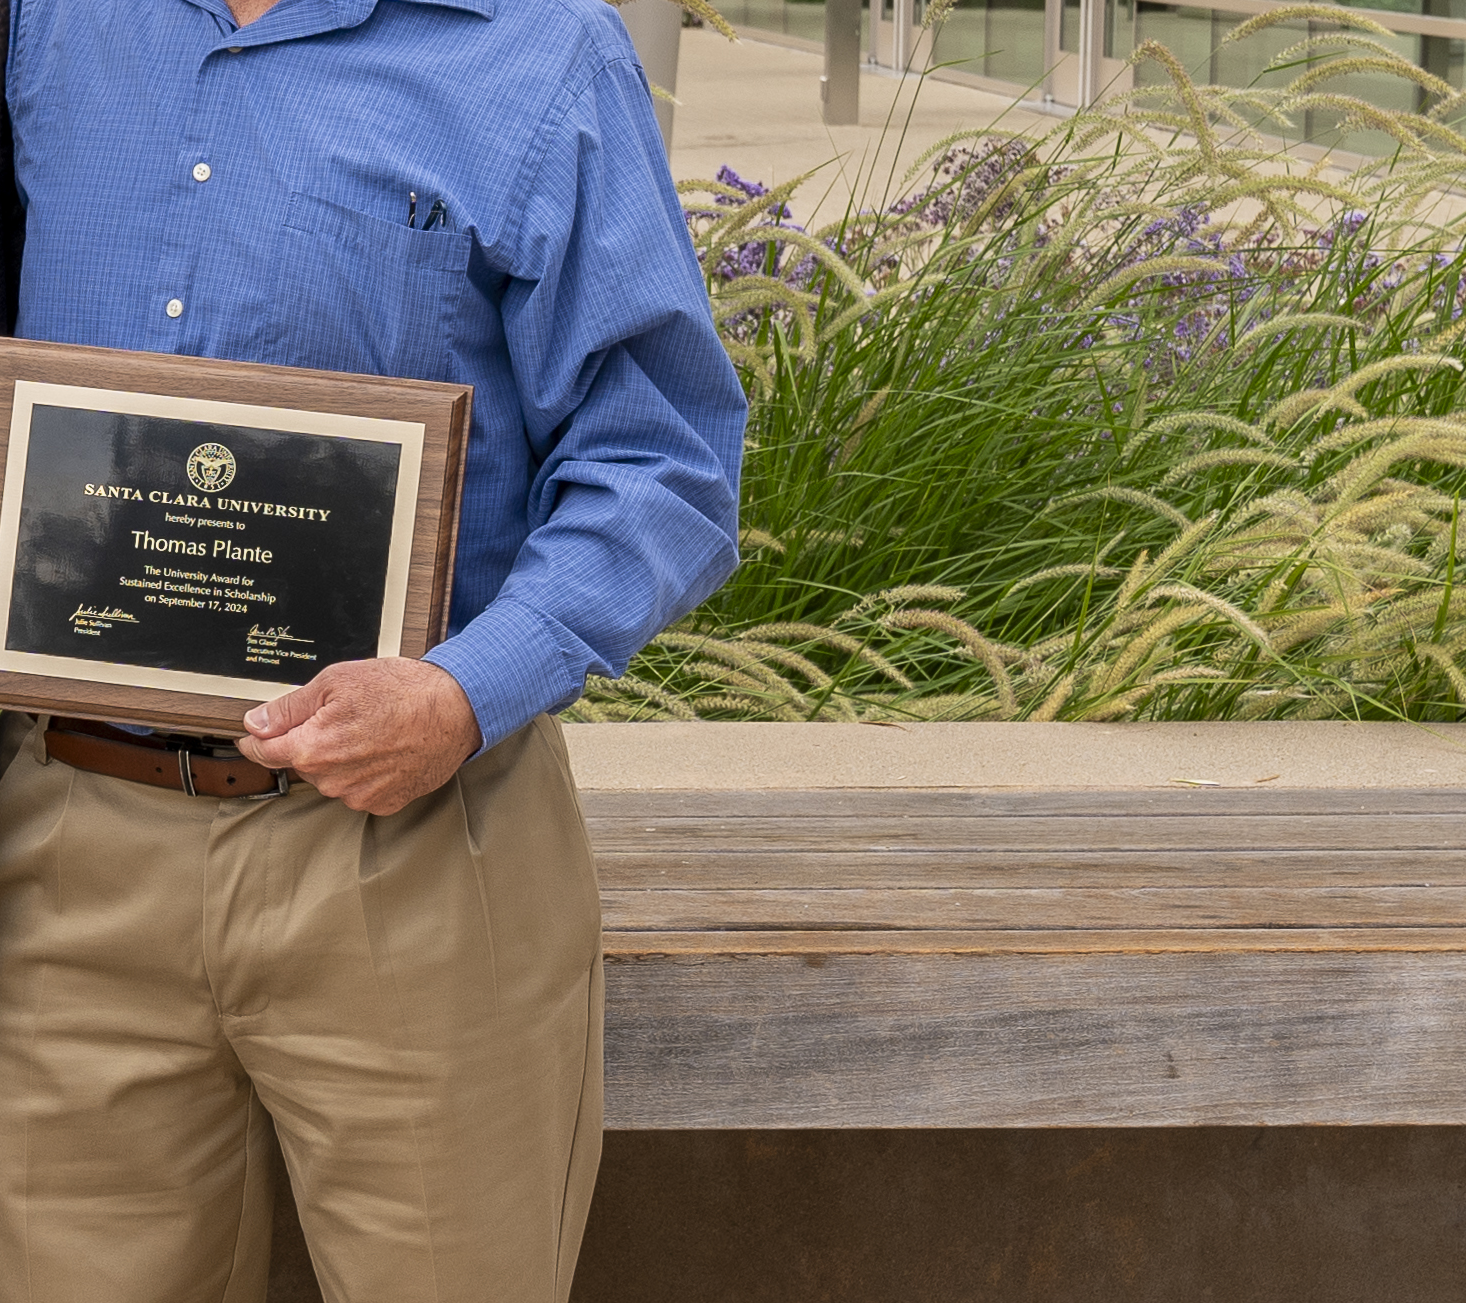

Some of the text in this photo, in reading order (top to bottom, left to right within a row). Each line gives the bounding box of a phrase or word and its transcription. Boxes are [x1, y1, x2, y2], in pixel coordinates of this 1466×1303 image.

[84, 483, 331, 521] SANTA CLARA UNIVERSITY
[165, 512, 245, 530] hereby presents to
[131, 530, 273, 563] Thomas Plante
[144, 565, 255, 586] The University Award for
[119, 576, 276, 605] Sustained Excellence in Scholarship
[144, 594, 248, 613] on September 17, 2024
[74, 627, 100, 636] President
[290, 651, 317, 661] President
